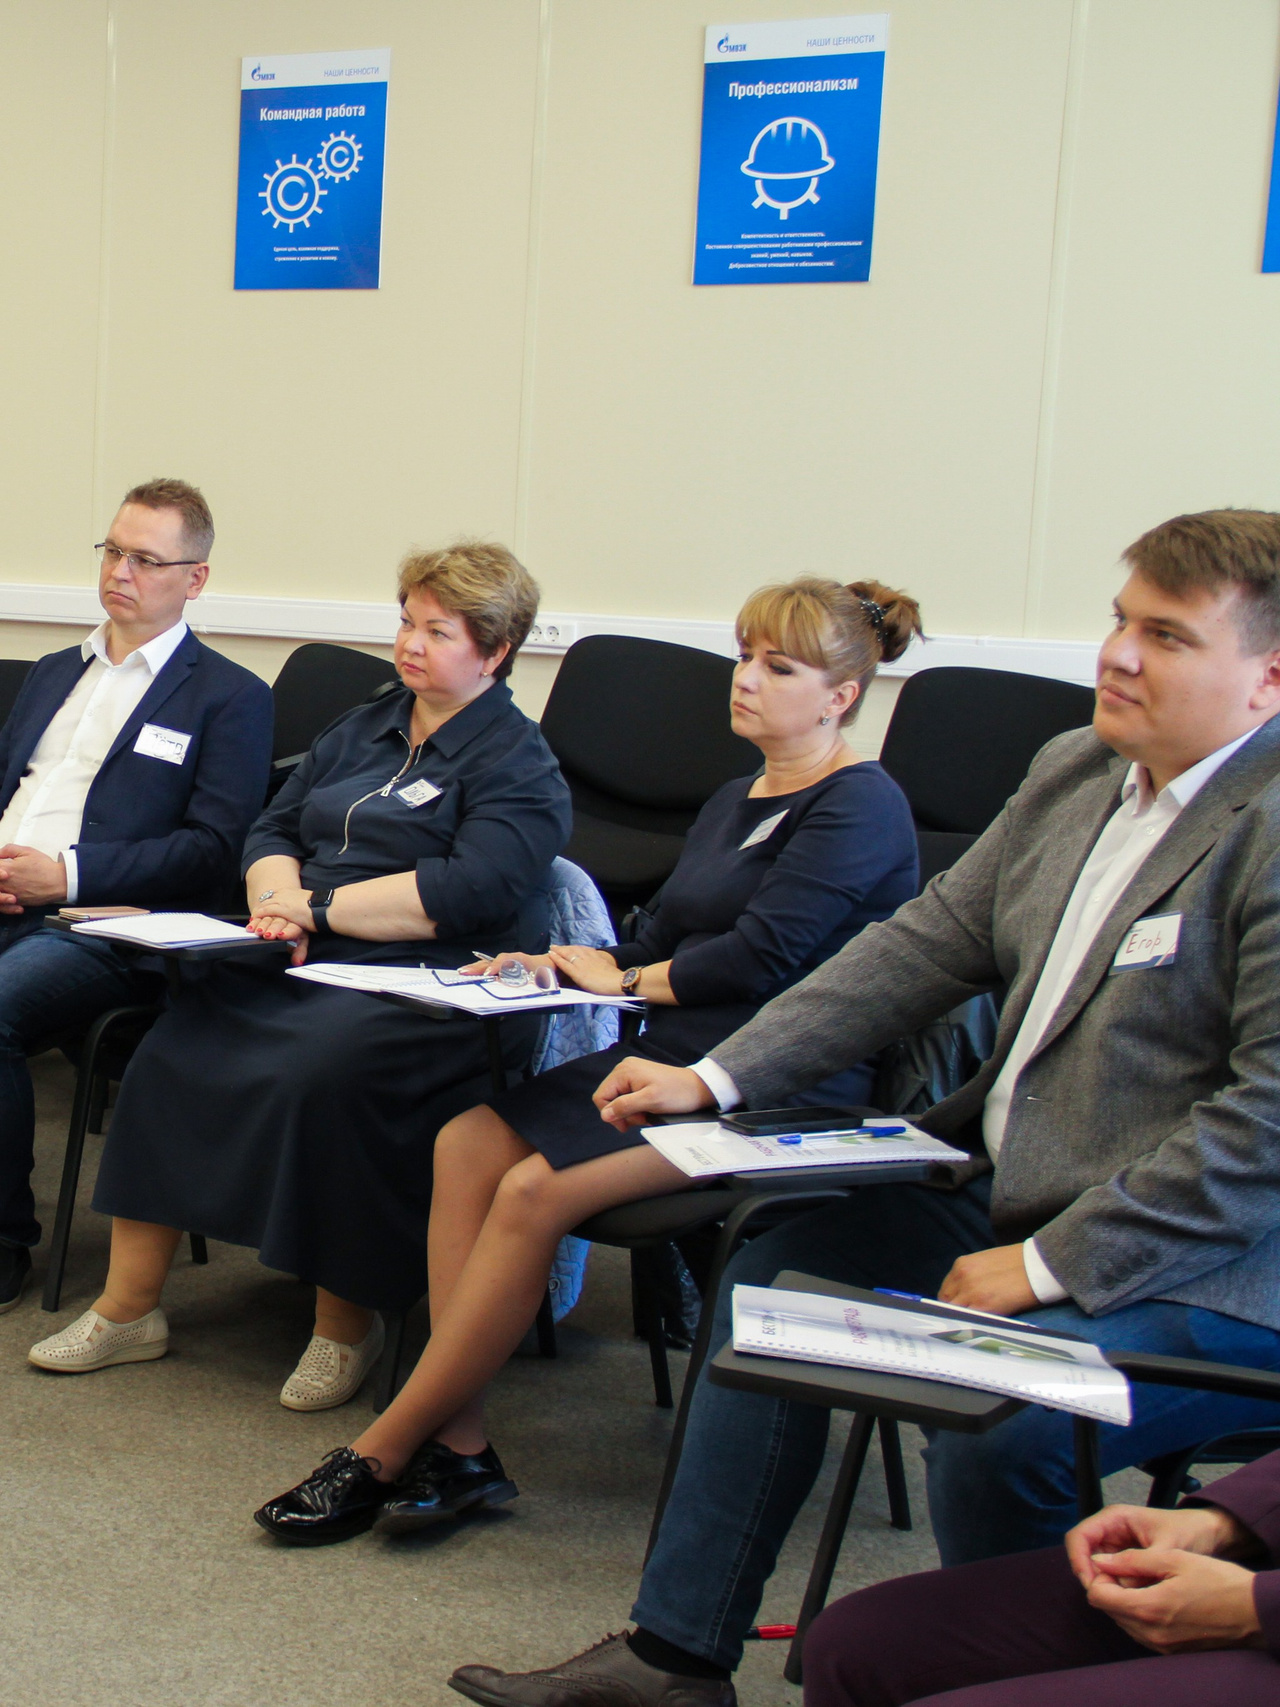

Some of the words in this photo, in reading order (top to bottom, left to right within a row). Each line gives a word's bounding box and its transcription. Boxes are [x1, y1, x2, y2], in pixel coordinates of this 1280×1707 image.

[806, 37, 831, 48] НАШИ
[832, 34, 876, 46] ЦЕННОСТИ
[323, 68, 344, 77] НАШИ
[344, 66, 380, 77] ЦЕННОСТИ
[728, 77, 859, 100] Профессионализм
[259, 107, 322, 122] Командная
[325, 104, 366, 121] работа
[1125, 930, 1162, 954] Егор
